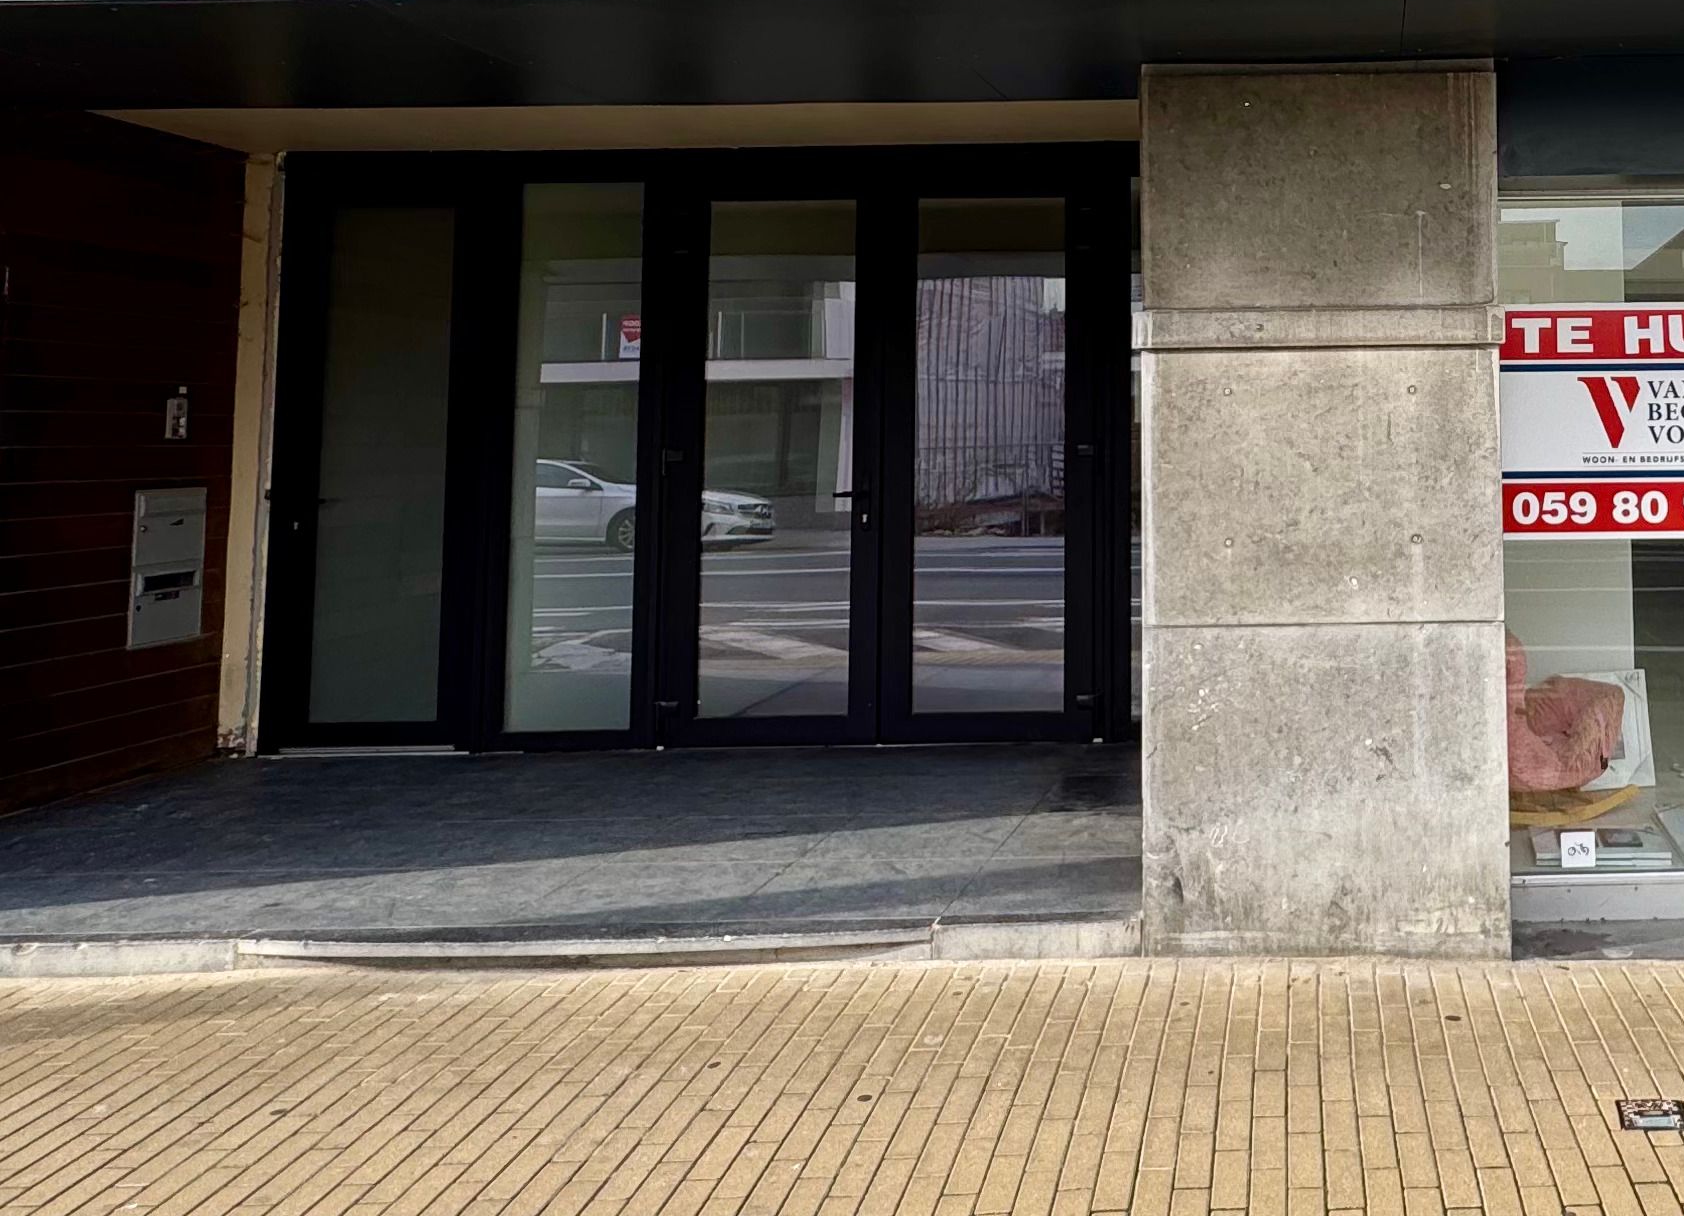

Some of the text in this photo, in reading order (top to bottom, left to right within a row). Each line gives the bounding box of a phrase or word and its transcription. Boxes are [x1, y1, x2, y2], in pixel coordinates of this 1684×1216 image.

[1511, 317, 1594, 353] TE
[1622, 455, 1636, 464] EN
[1512, 491, 1598, 525] 059
[1611, 490, 1669, 524] 80
